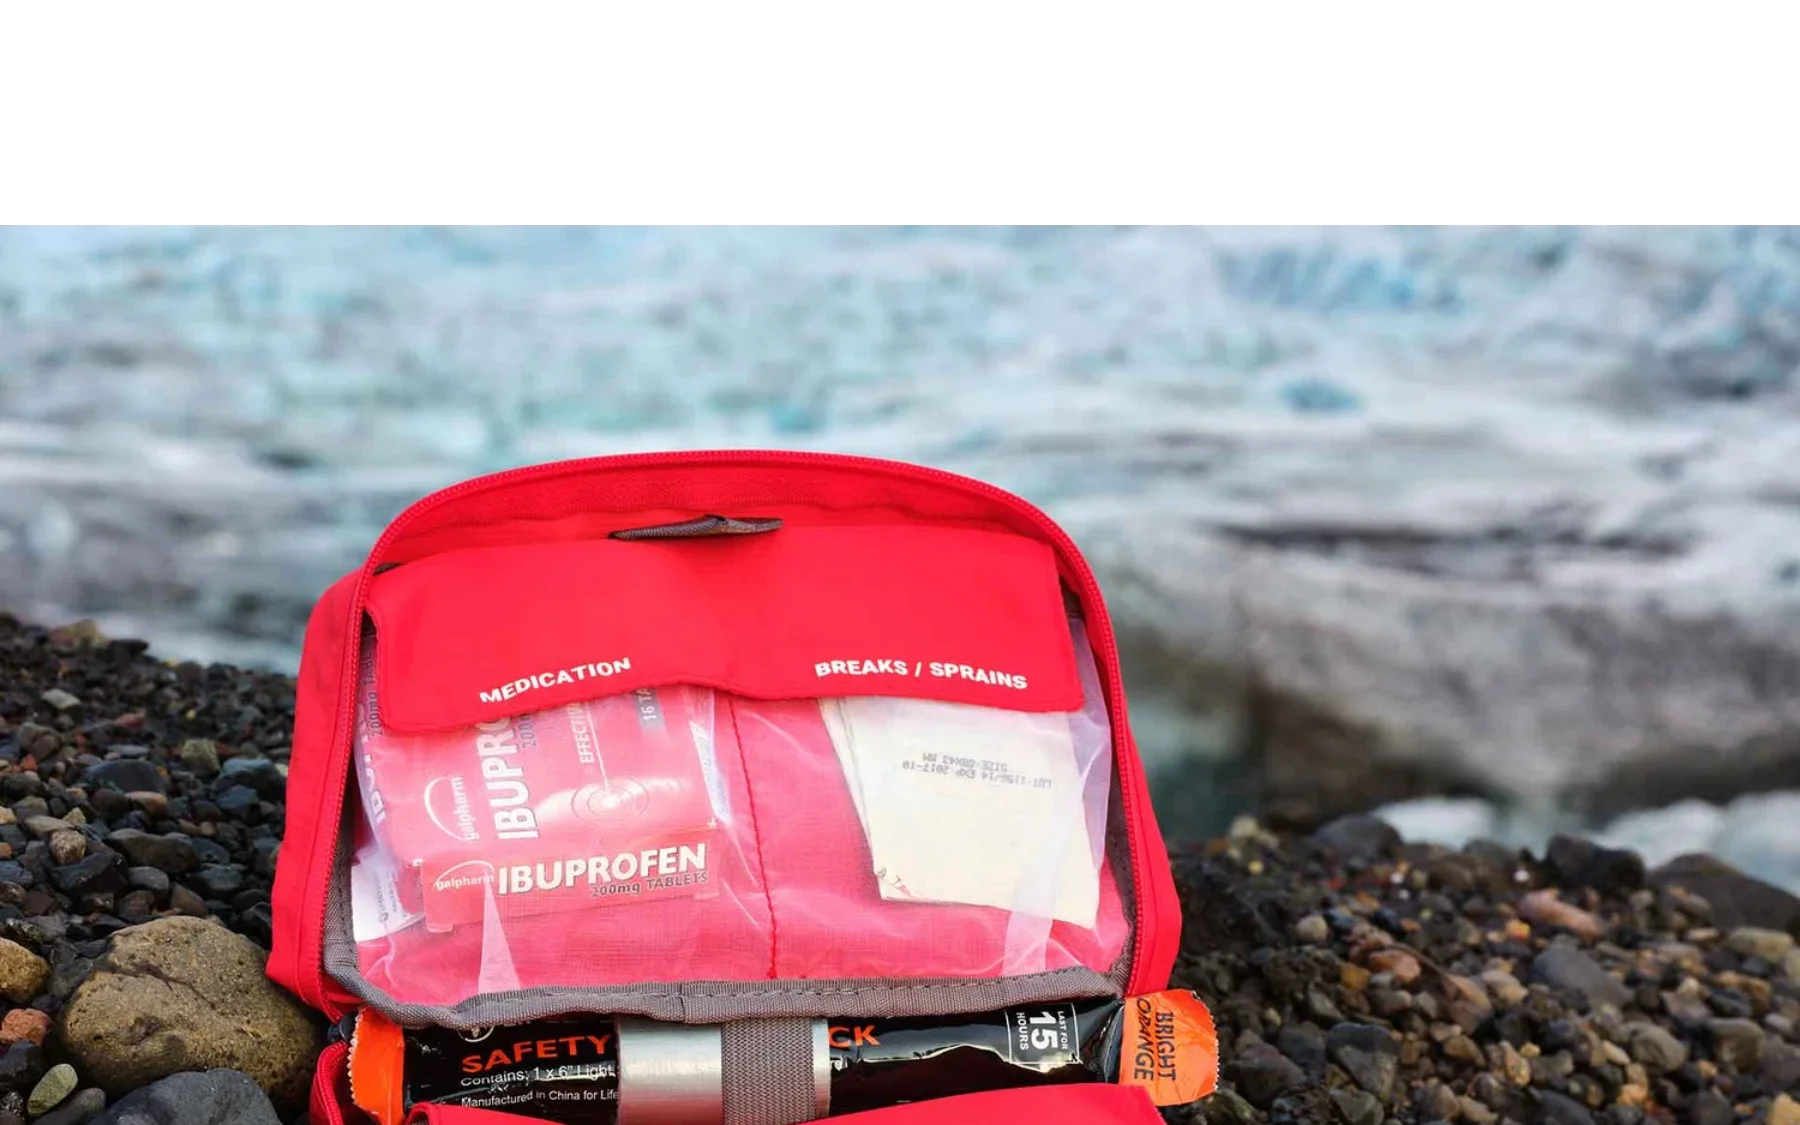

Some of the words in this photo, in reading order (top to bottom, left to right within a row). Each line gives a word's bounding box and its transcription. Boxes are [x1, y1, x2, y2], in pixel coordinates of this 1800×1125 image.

[479, 657, 631, 704] MEDICATION
[814, 659, 908, 677] BREAKS
[914, 661, 922, 677] /
[929, 662, 1028, 690] SPRAINS
[641, 705, 658, 720] 16
[498, 843, 707, 896] IBUPROFEN
[591, 882, 641, 898] 200mg
[646, 871, 708, 890] TABLETS
[1016, 1011, 1030, 1051] HOURS
[1028, 1010, 1058, 1050] 15
[1057, 1010, 1068, 1030] LAST
[1133, 998, 1155, 1081] ORANGE
[462, 1033, 611, 1073] SAFETY
[1059, 1031, 1069, 1050] FOR
[1154, 1011, 1176, 1081] BRIGHT
[461, 1090, 534, 1108] Manufactured
[535, 1090, 546, 1099] in
[548, 1090, 580, 1100] China
[582, 1089, 598, 1100] for
